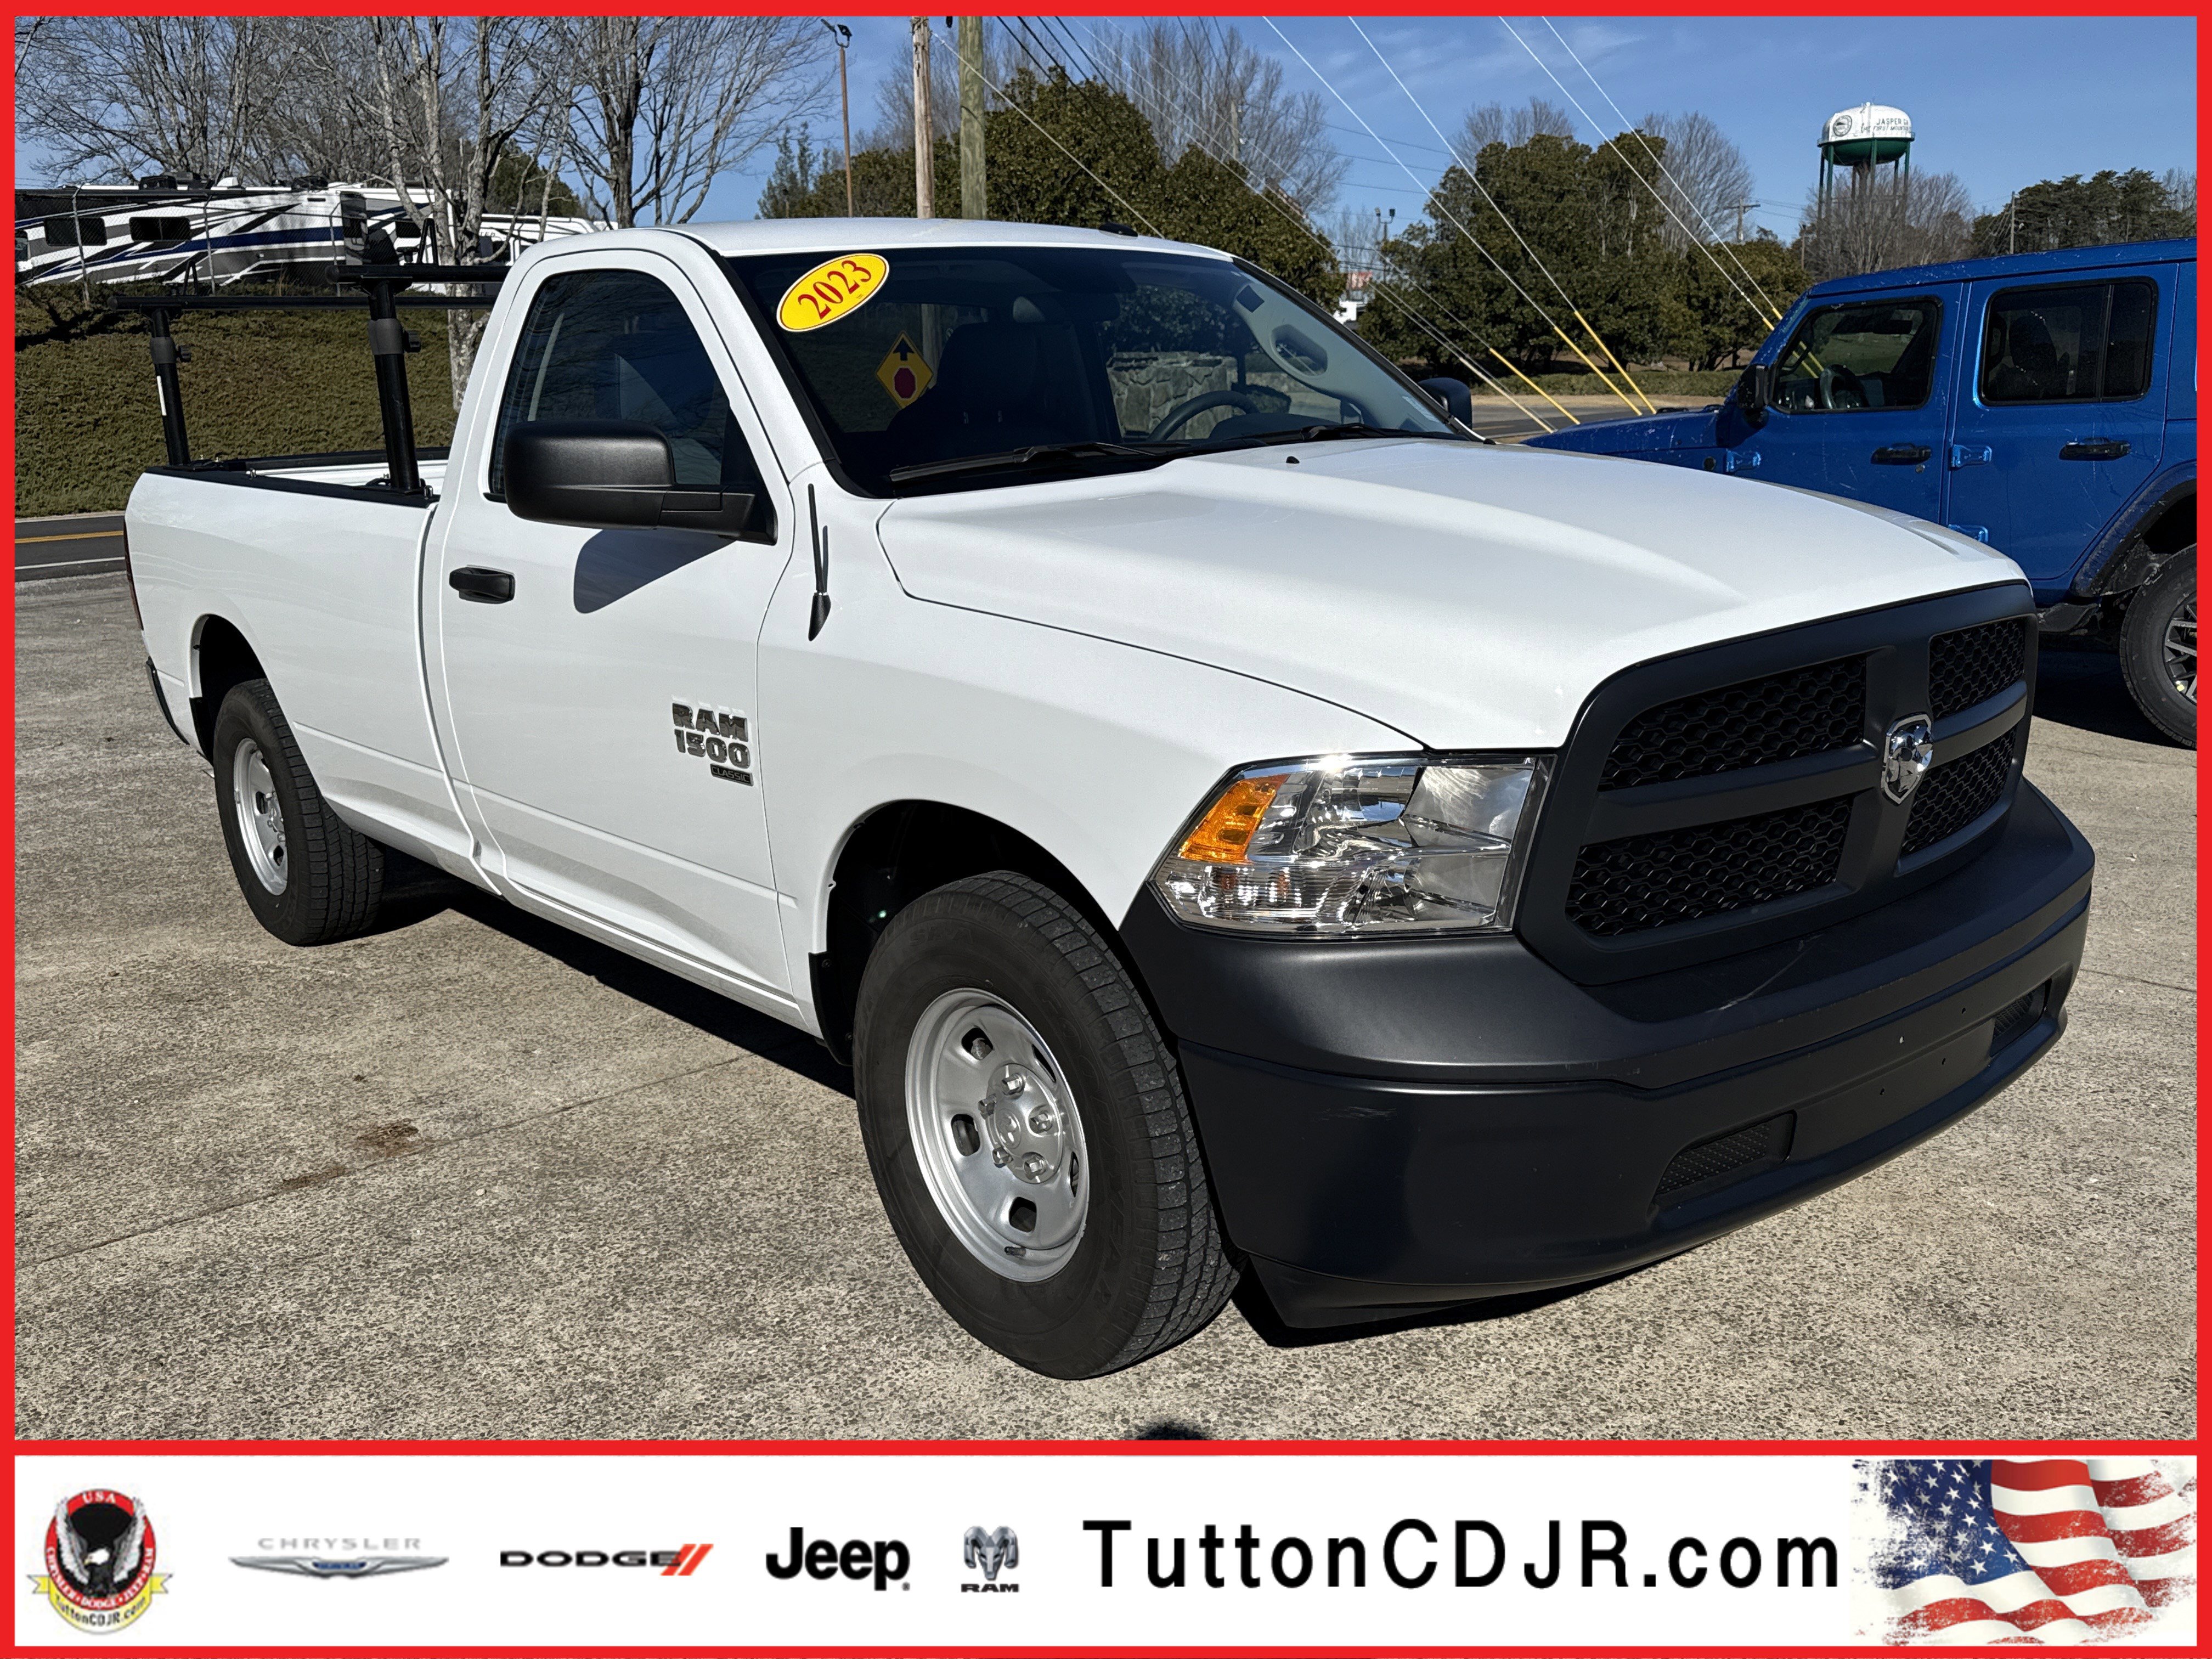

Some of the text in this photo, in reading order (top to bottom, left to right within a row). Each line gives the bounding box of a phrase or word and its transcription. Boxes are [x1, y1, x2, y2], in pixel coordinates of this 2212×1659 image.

[798, 259, 872, 320] 2023
[672, 702, 749, 742] RAM
[674, 729, 751, 769] 1500
[712, 766, 750, 783] CLASSIC
